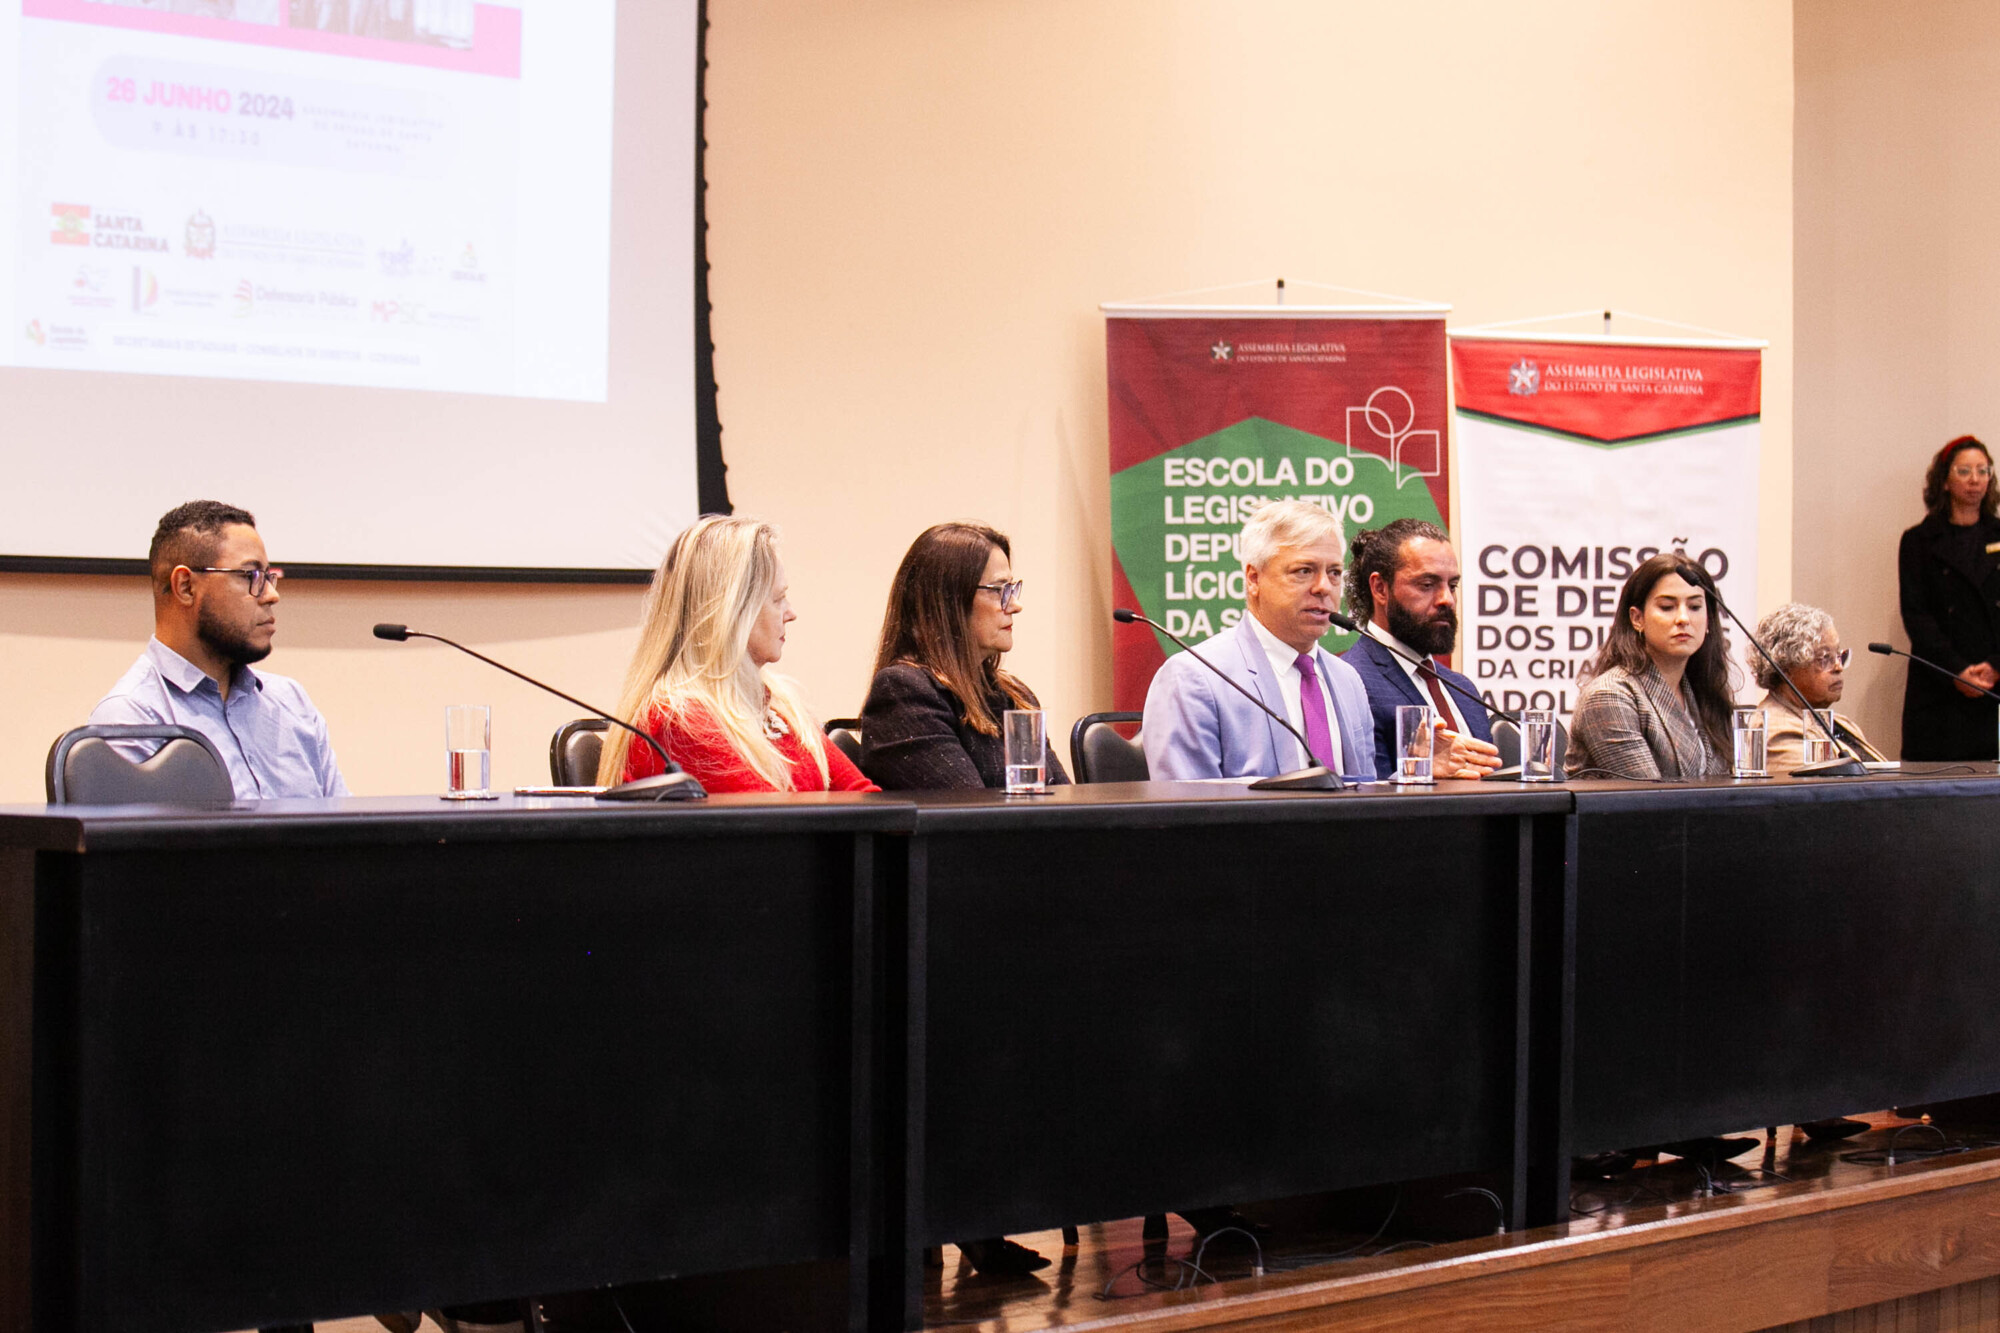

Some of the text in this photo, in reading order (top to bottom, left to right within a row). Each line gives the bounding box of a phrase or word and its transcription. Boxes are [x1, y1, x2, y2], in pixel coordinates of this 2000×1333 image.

[107, 76, 136, 103] 26
[143, 81, 232, 113] JUNHO
[239, 91, 295, 120] 2024
[94, 214, 143, 232] SANTA
[93, 233, 170, 252] CATARINA
[1238, 342, 1346, 353] ASSEMBLEIA LEGISLATIVA
[1545, 364, 1703, 381] ASSEMBLEIA LEGISLATIVA
[1544, 381, 1703, 395] DO ESTADO DE SANTA CATARINA
[1164, 457, 1354, 487] ESCOLA DO
[1165, 564, 1246, 600] LÍCIO
[1478, 584, 1539, 617] DE
[1165, 609, 1214, 638] DA
[1477, 625, 1555, 650] DOS
[1477, 659, 1517, 679] DA
